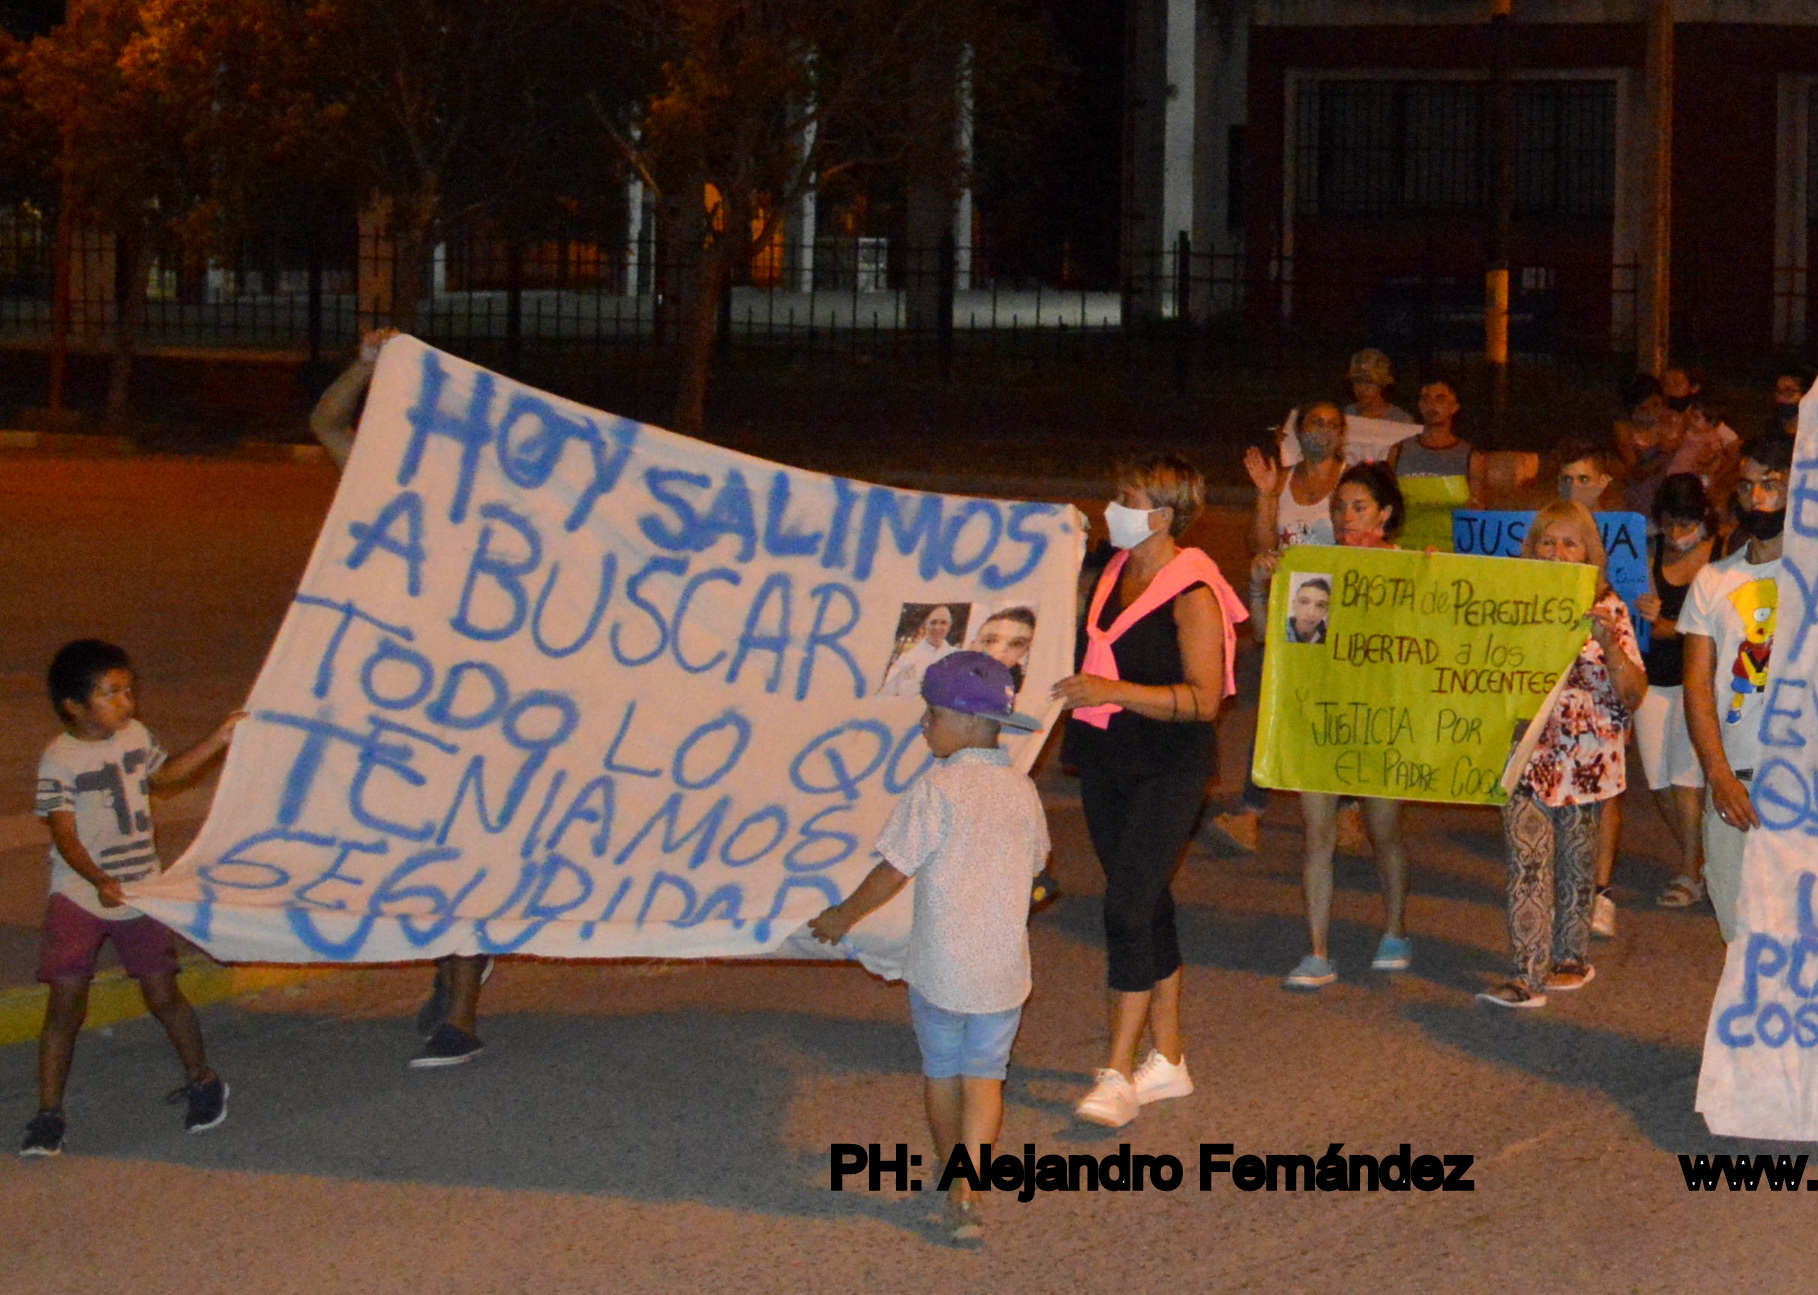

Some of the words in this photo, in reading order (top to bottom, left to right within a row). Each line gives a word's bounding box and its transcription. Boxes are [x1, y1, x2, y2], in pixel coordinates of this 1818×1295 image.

[396, 350, 638, 531] HOY
[347, 490, 426, 596] A
[450, 502, 867, 701] BUSCAR
[1341, 570, 1415, 612] BASTA
[1420, 588, 1450, 616] de
[1334, 632, 1439, 667] LIBERTAD
[1485, 633, 1525, 668] los
[292, 592, 580, 750] TODO
[603, 700, 753, 793] LO
[1431, 667, 1558, 695] INOCENTES
[1311, 701, 1414, 746] JUSTICIA
[1437, 708, 1482, 744] POR
[1335, 750, 1370, 785] EL
[1383, 749, 1438, 793] PADRE
